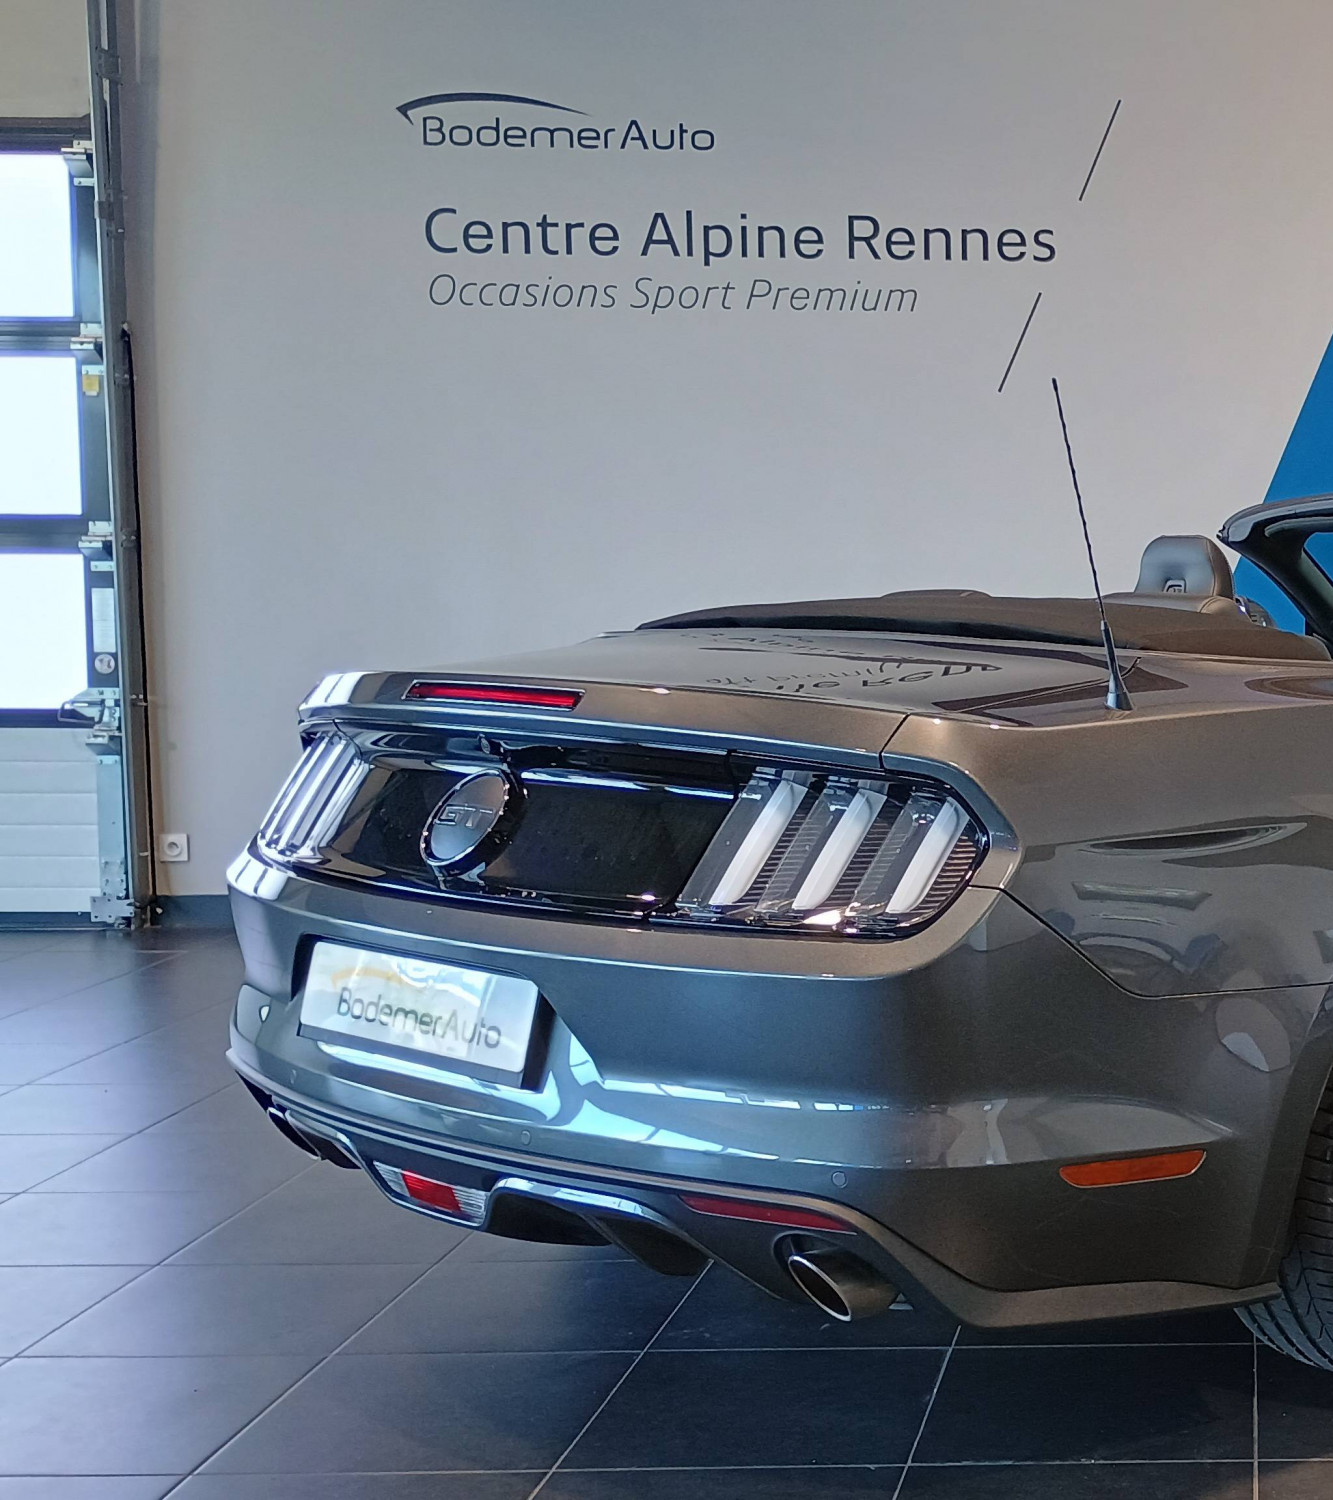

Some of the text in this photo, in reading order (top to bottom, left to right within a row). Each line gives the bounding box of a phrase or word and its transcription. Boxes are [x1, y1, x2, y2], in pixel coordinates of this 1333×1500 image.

[422, 115, 715, 151] BodemerAuto
[424, 207, 1057, 267] Centre Alpine Rennes
[428, 273, 919, 315] Occasions Sport Premium
[434, 806, 495, 829] GT
[336, 985, 501, 1050] BodemerAuto
